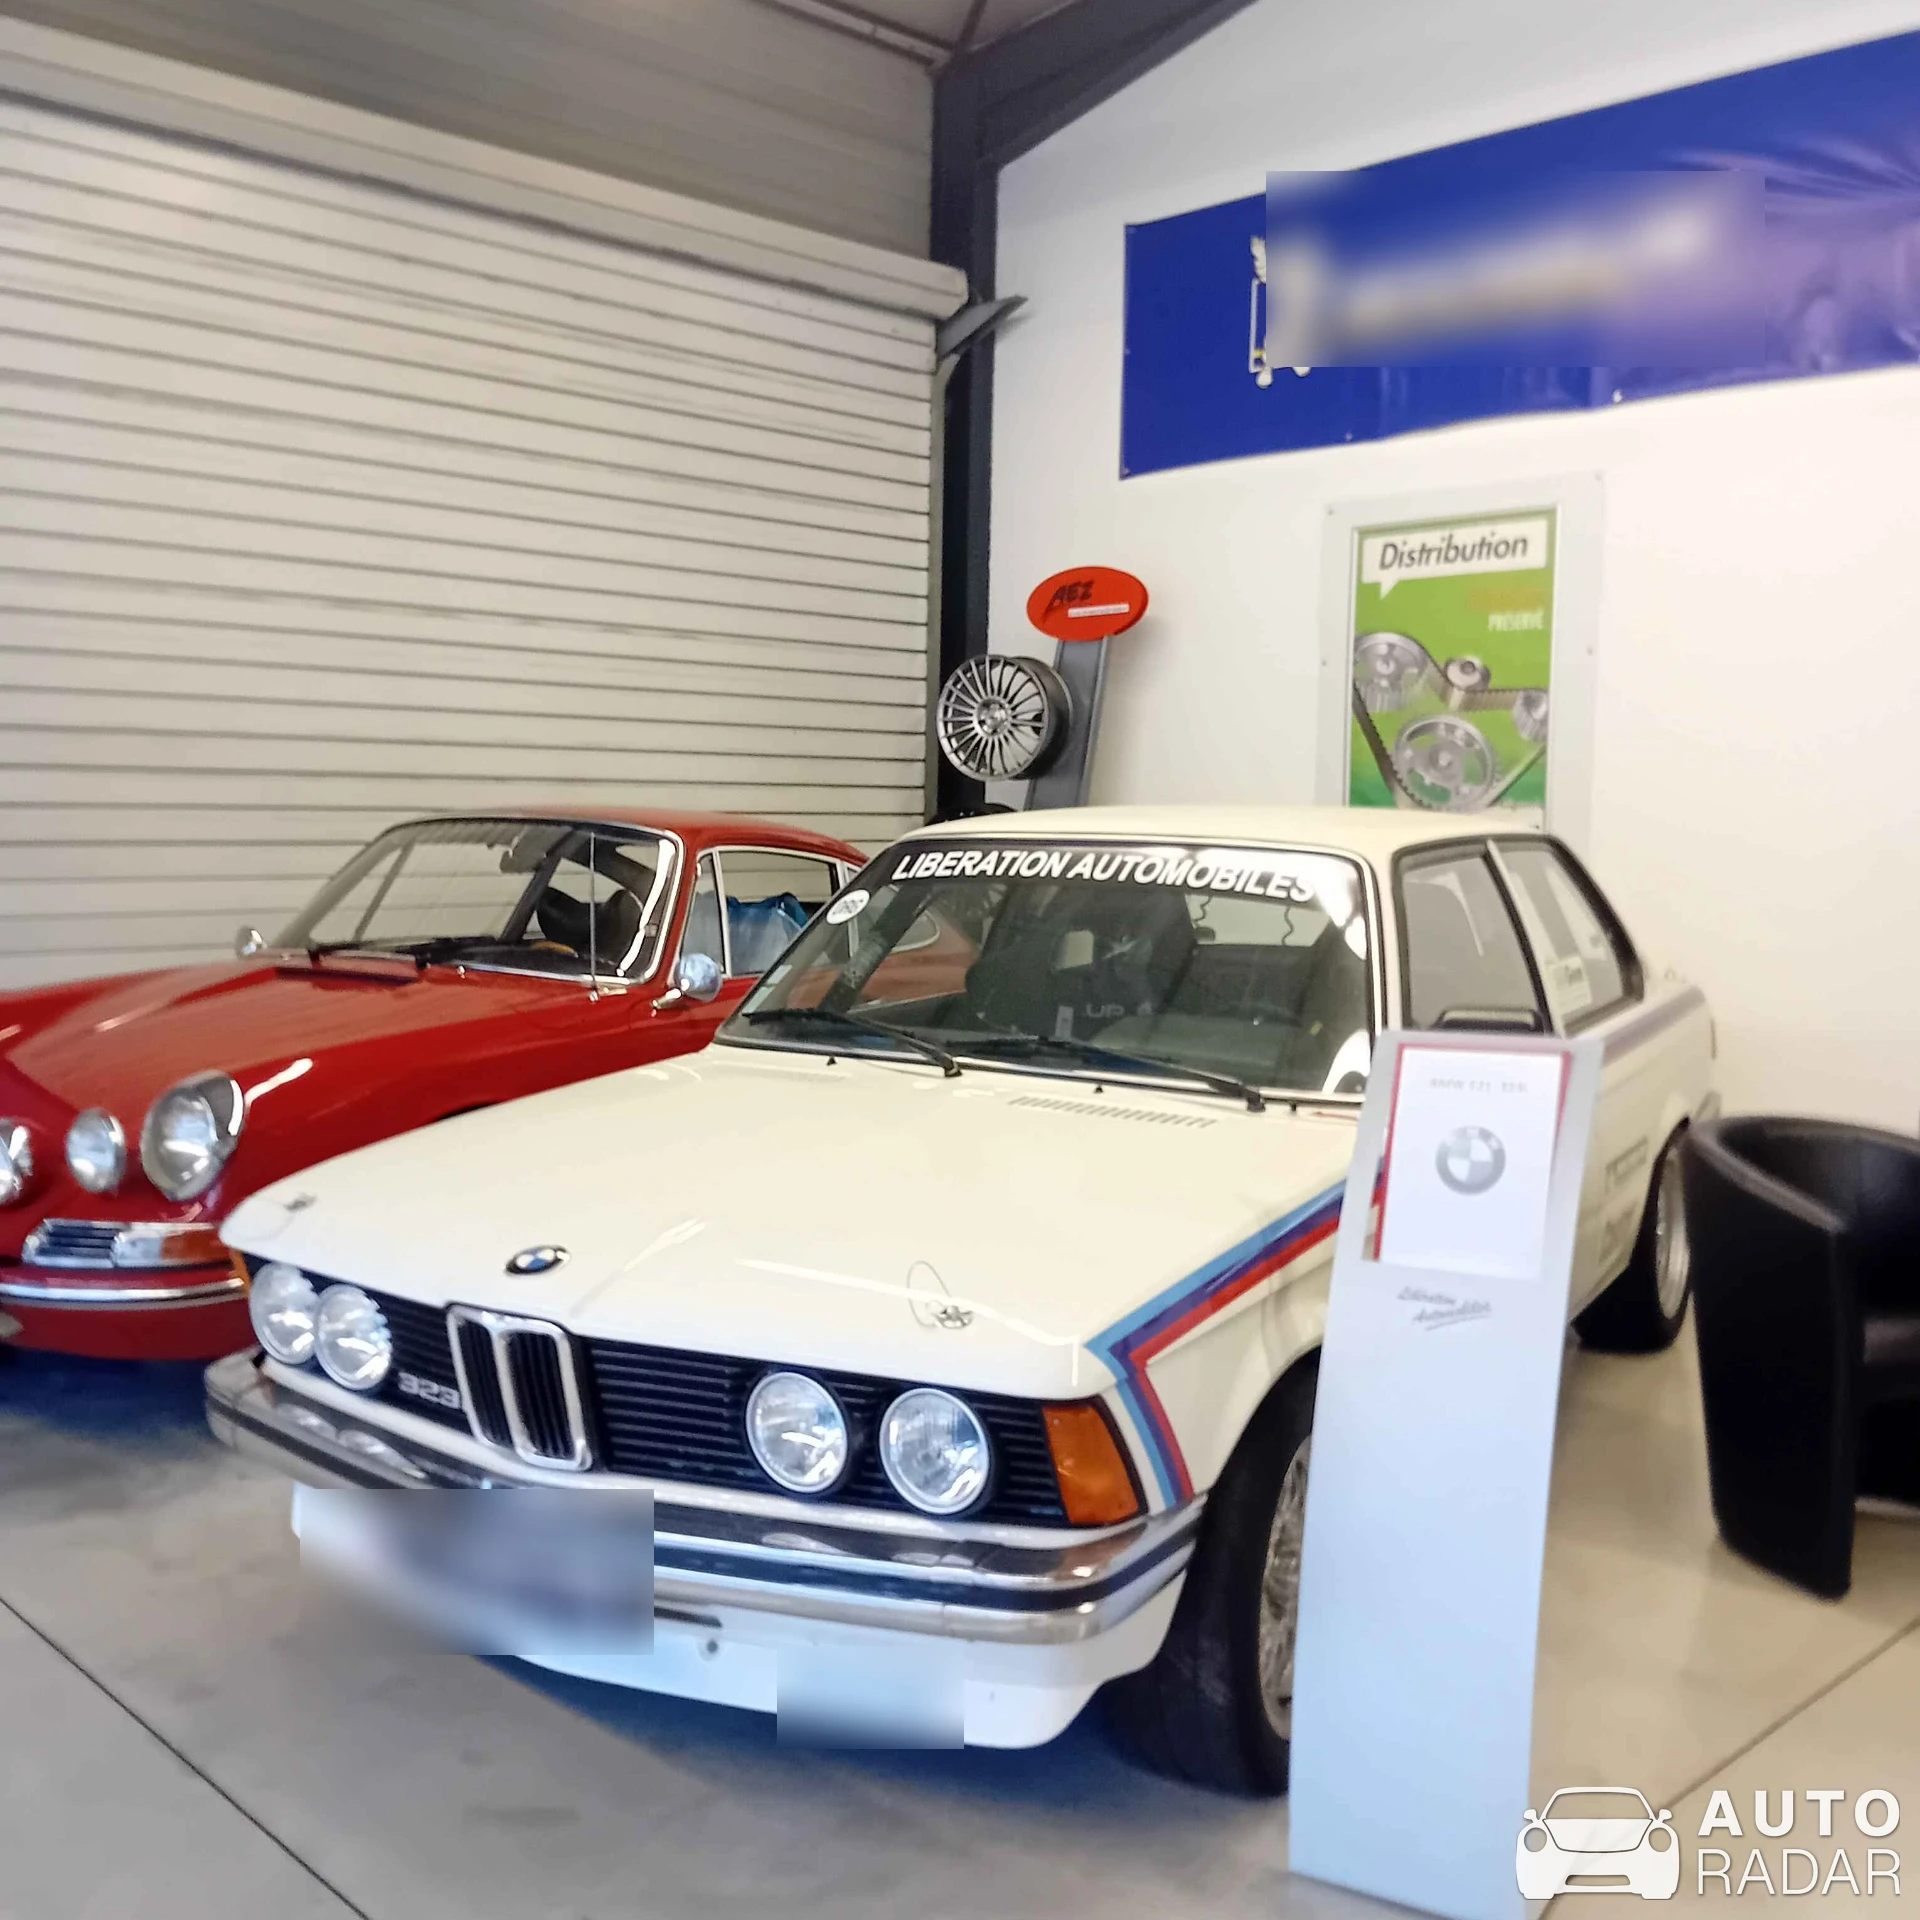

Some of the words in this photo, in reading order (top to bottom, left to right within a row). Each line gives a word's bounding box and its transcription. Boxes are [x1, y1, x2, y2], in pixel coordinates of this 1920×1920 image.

[1379, 533, 1529, 571] Distribution
[891, 850, 1069, 881] LIBERATION
[1070, 852, 1317, 902] AUTOMOBILES
[397, 1372, 460, 1410] 323
